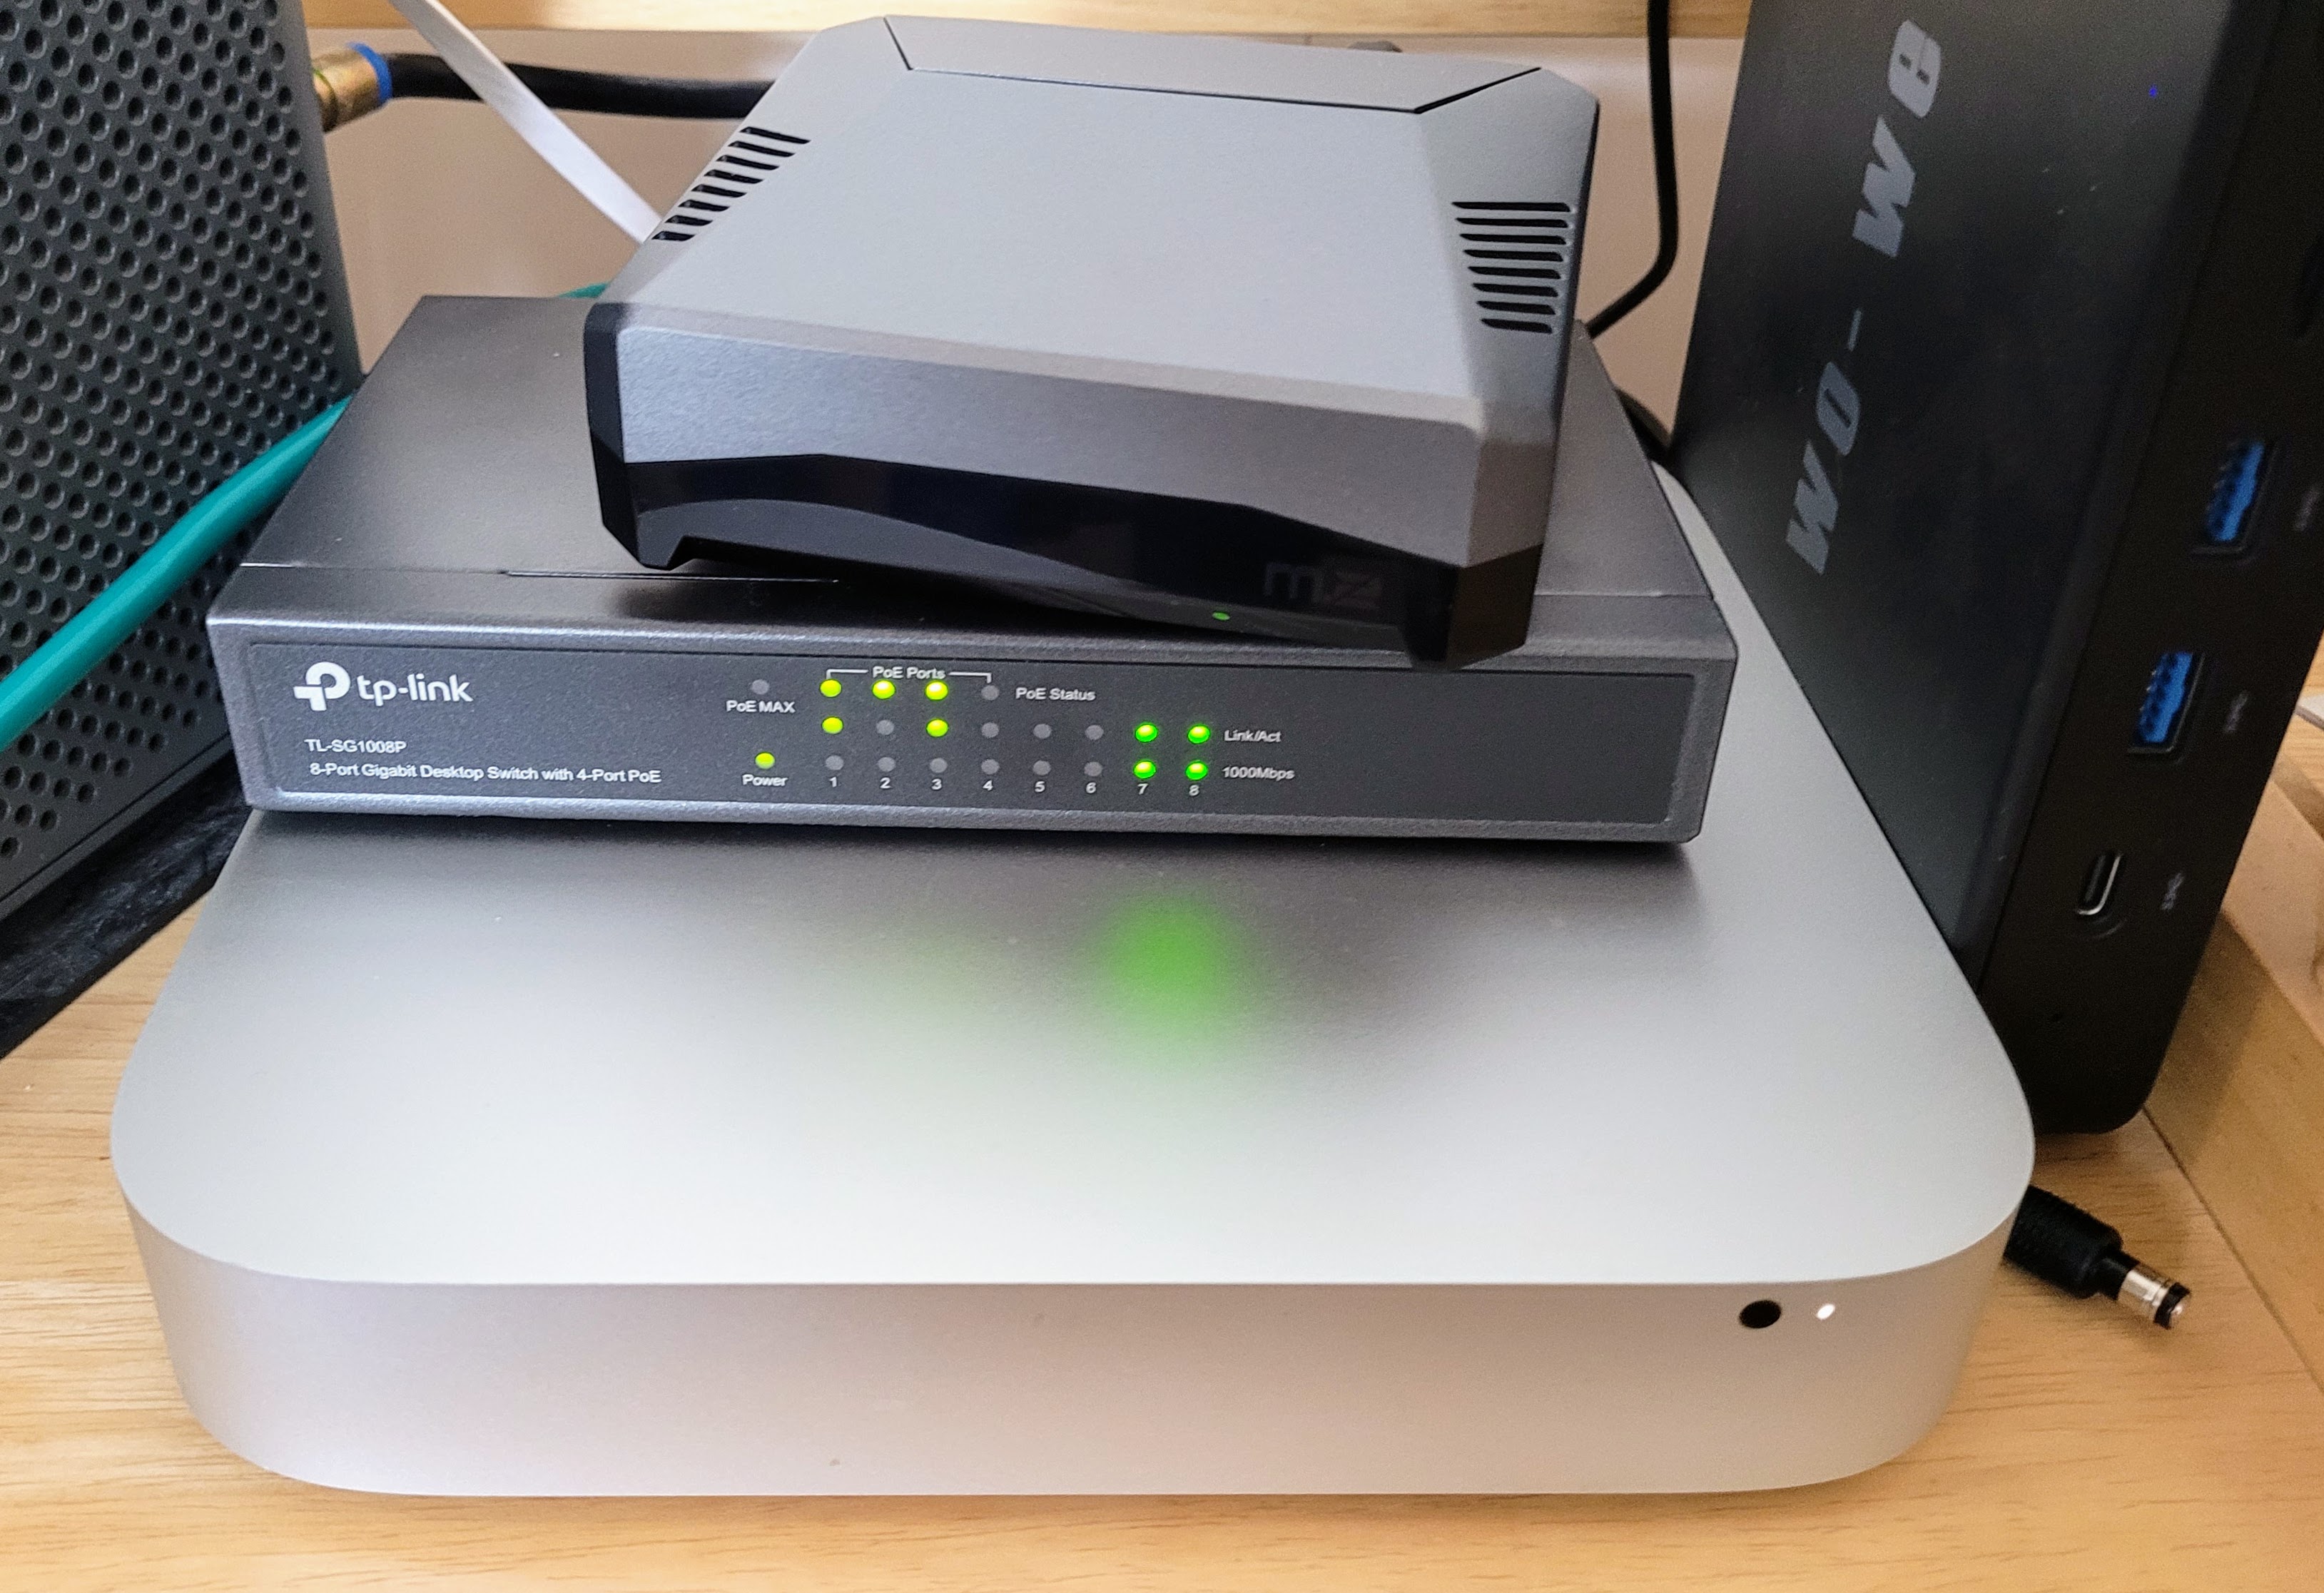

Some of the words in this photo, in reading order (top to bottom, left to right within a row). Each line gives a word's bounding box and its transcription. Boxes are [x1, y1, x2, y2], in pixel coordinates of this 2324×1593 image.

[872, 666, 904, 678] PoE
[907, 667, 946, 679] Ports
[357, 673, 474, 706] tp-link
[1015, 687, 1047, 700] PoE
[1049, 688, 1096, 701] Status
[726, 700, 757, 713] PoE
[758, 701, 796, 713] MAX
[1224, 729, 1282, 743] Link/Act
[304, 738, 407, 753] TL-SG1008P
[310, 763, 360, 776] 8-Port
[361, 763, 417, 779] Gigabit
[420, 765, 484, 781] Desktop
[487, 766, 538, 780] Switch
[541, 768, 573, 781] with
[576, 768, 626, 782] 4-Port
[627, 770, 661, 783] PoE
[742, 773, 788, 787] Power
[1222, 766, 1295, 781] 1000Mbps
[829, 776, 838, 788] 1
[880, 778, 891, 790] 2
[931, 778, 943, 790] 3
[983, 780, 993, 791] 4
[1035, 781, 1045, 793] 5
[1085, 783, 1097, 794] 6
[1137, 783, 1148, 795] 7
[1189, 784, 1200, 796] 8
